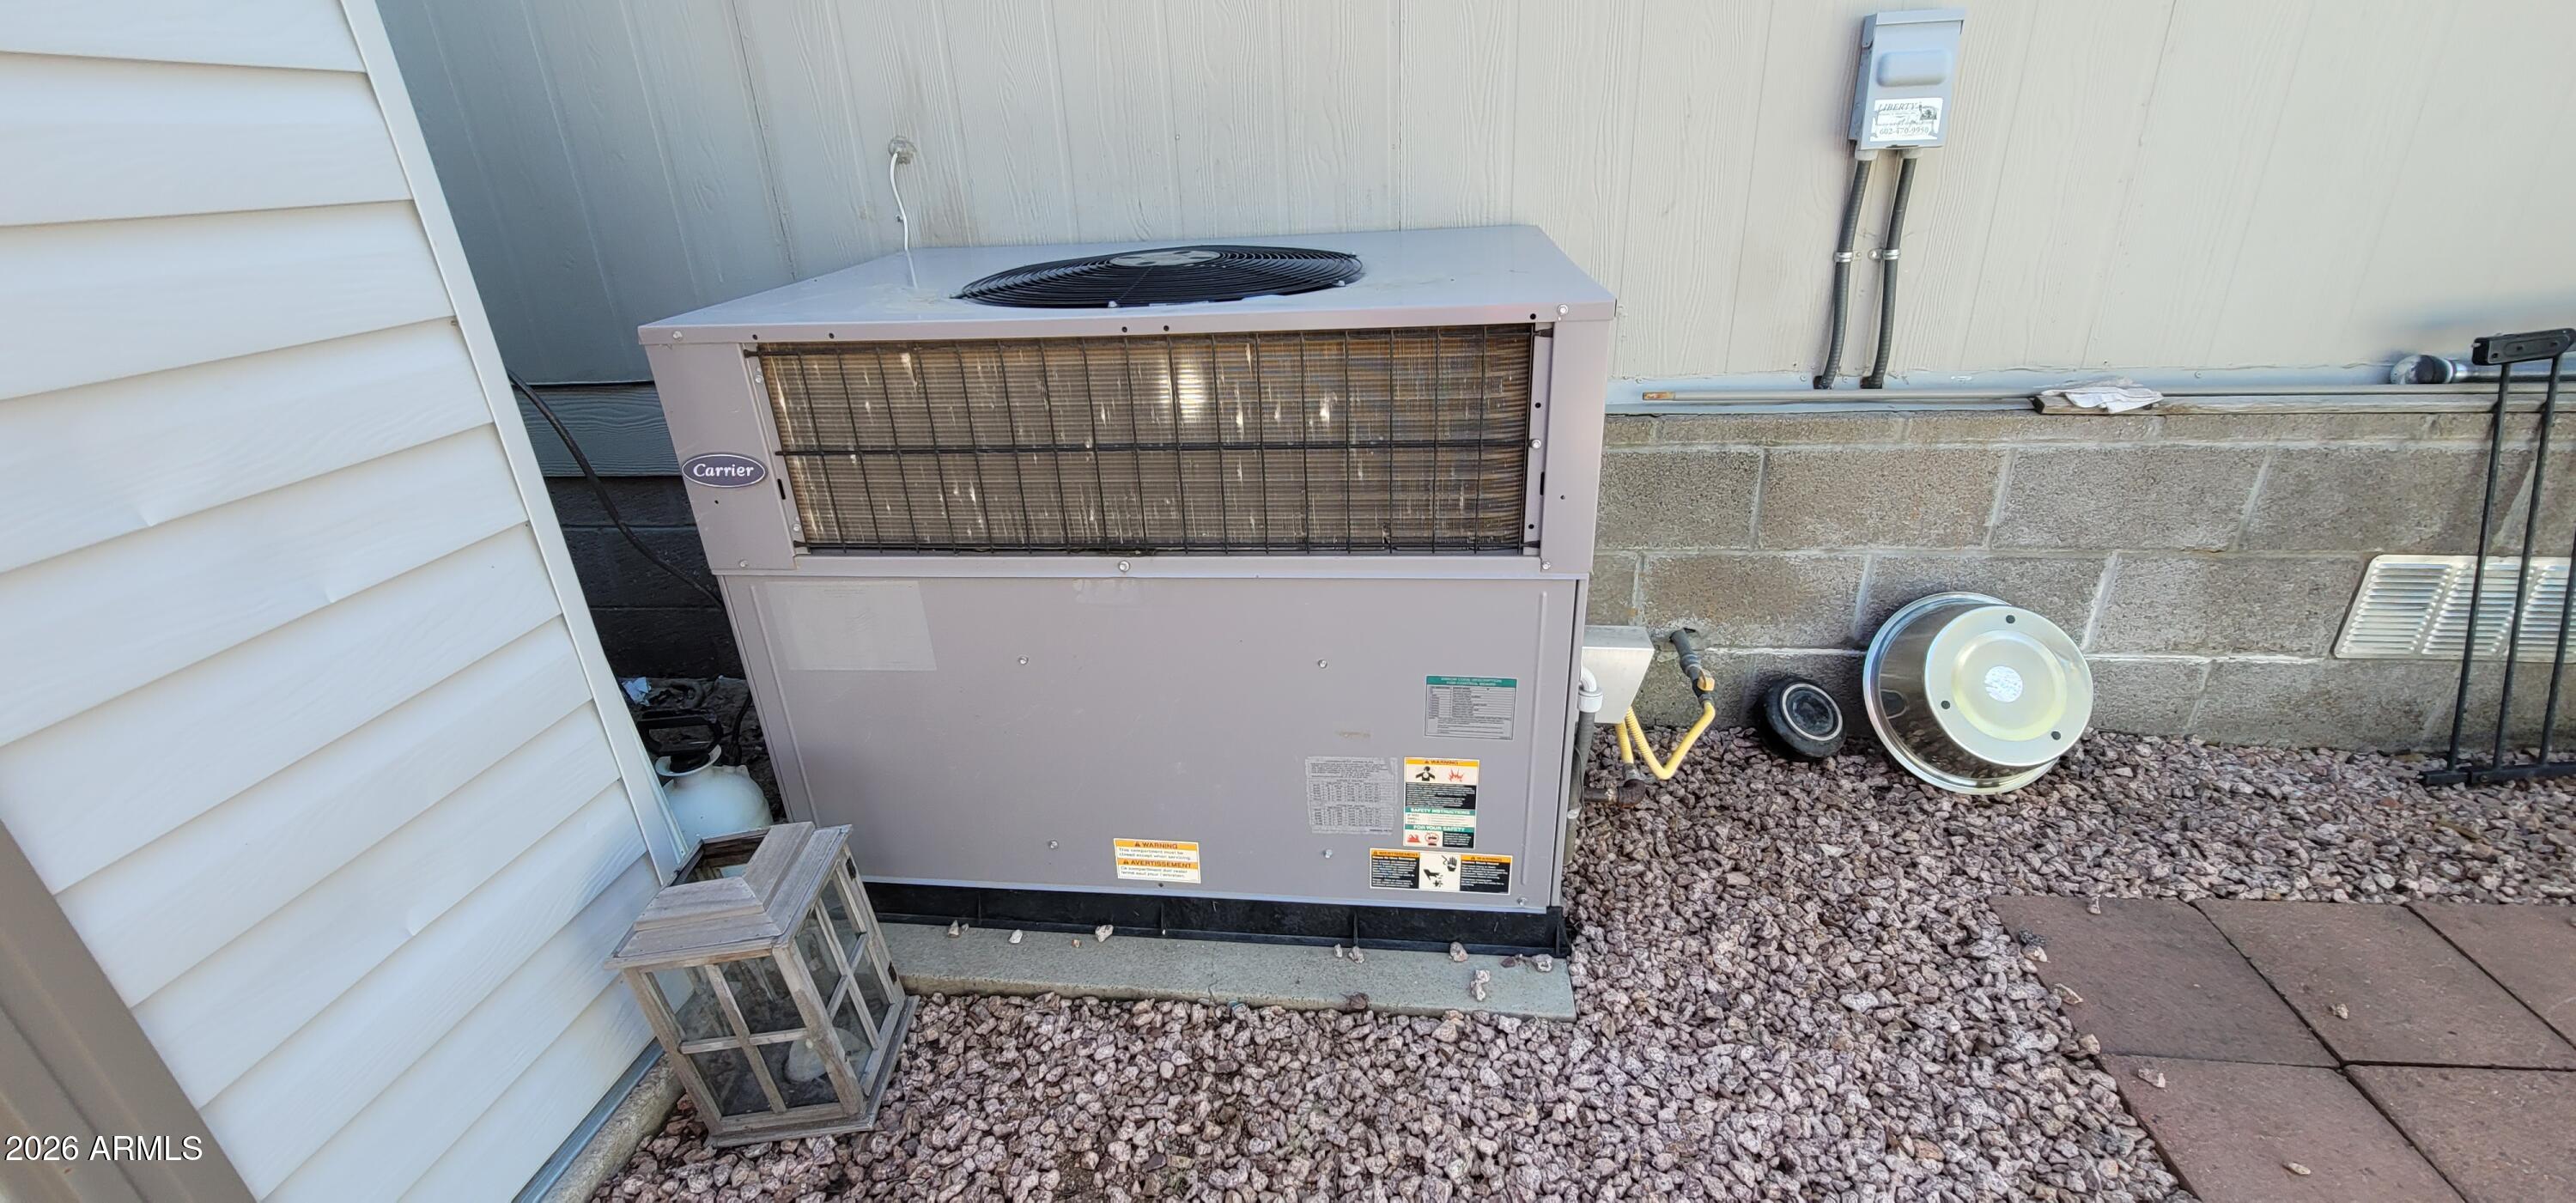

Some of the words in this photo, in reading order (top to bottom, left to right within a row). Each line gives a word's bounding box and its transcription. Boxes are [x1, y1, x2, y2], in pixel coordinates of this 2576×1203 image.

[1878, 102, 1918, 112] LIBERTY
[693, 463, 754, 477] Carrier
[1142, 841, 1178, 850] WARNING
[1130, 860, 1192, 869] AVERTISSEMENT
